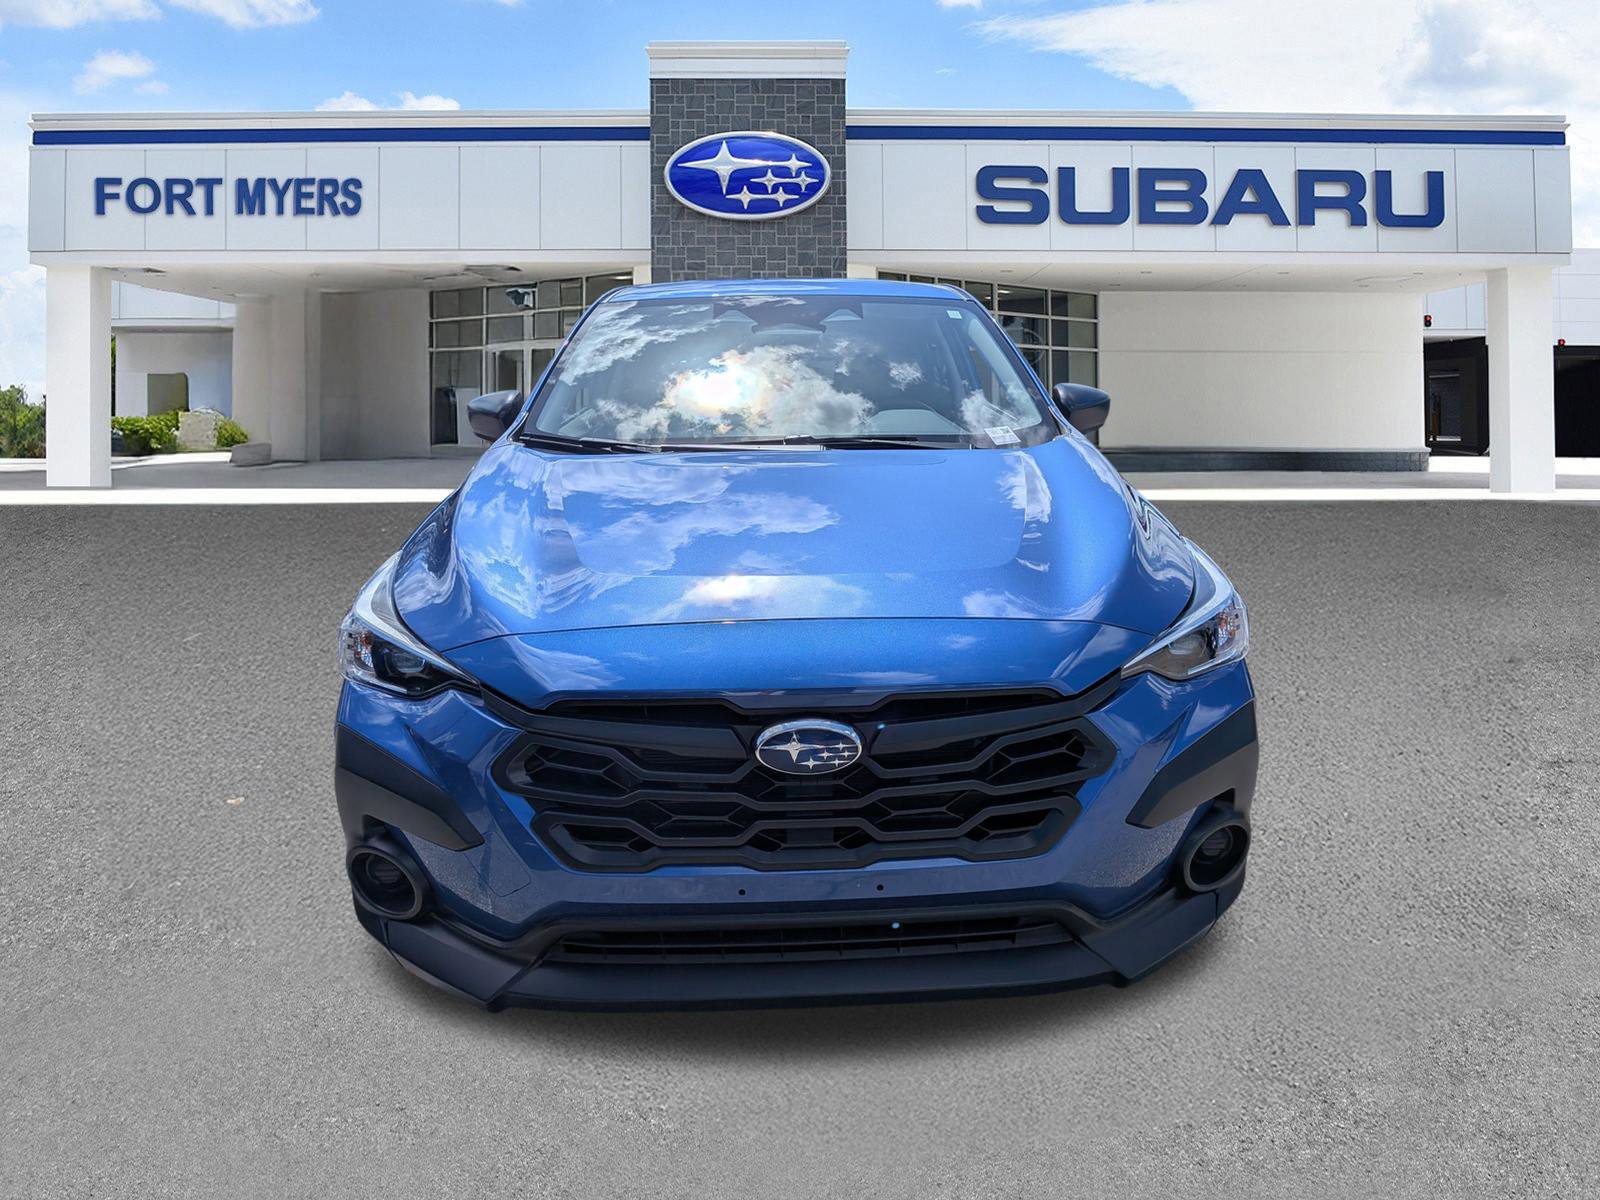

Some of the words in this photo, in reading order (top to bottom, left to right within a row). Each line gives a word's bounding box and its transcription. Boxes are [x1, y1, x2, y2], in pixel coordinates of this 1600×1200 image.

[94, 177, 223, 216] FORT
[235, 178, 362, 217] MYERS
[976, 165, 1445, 228] SUBARU
